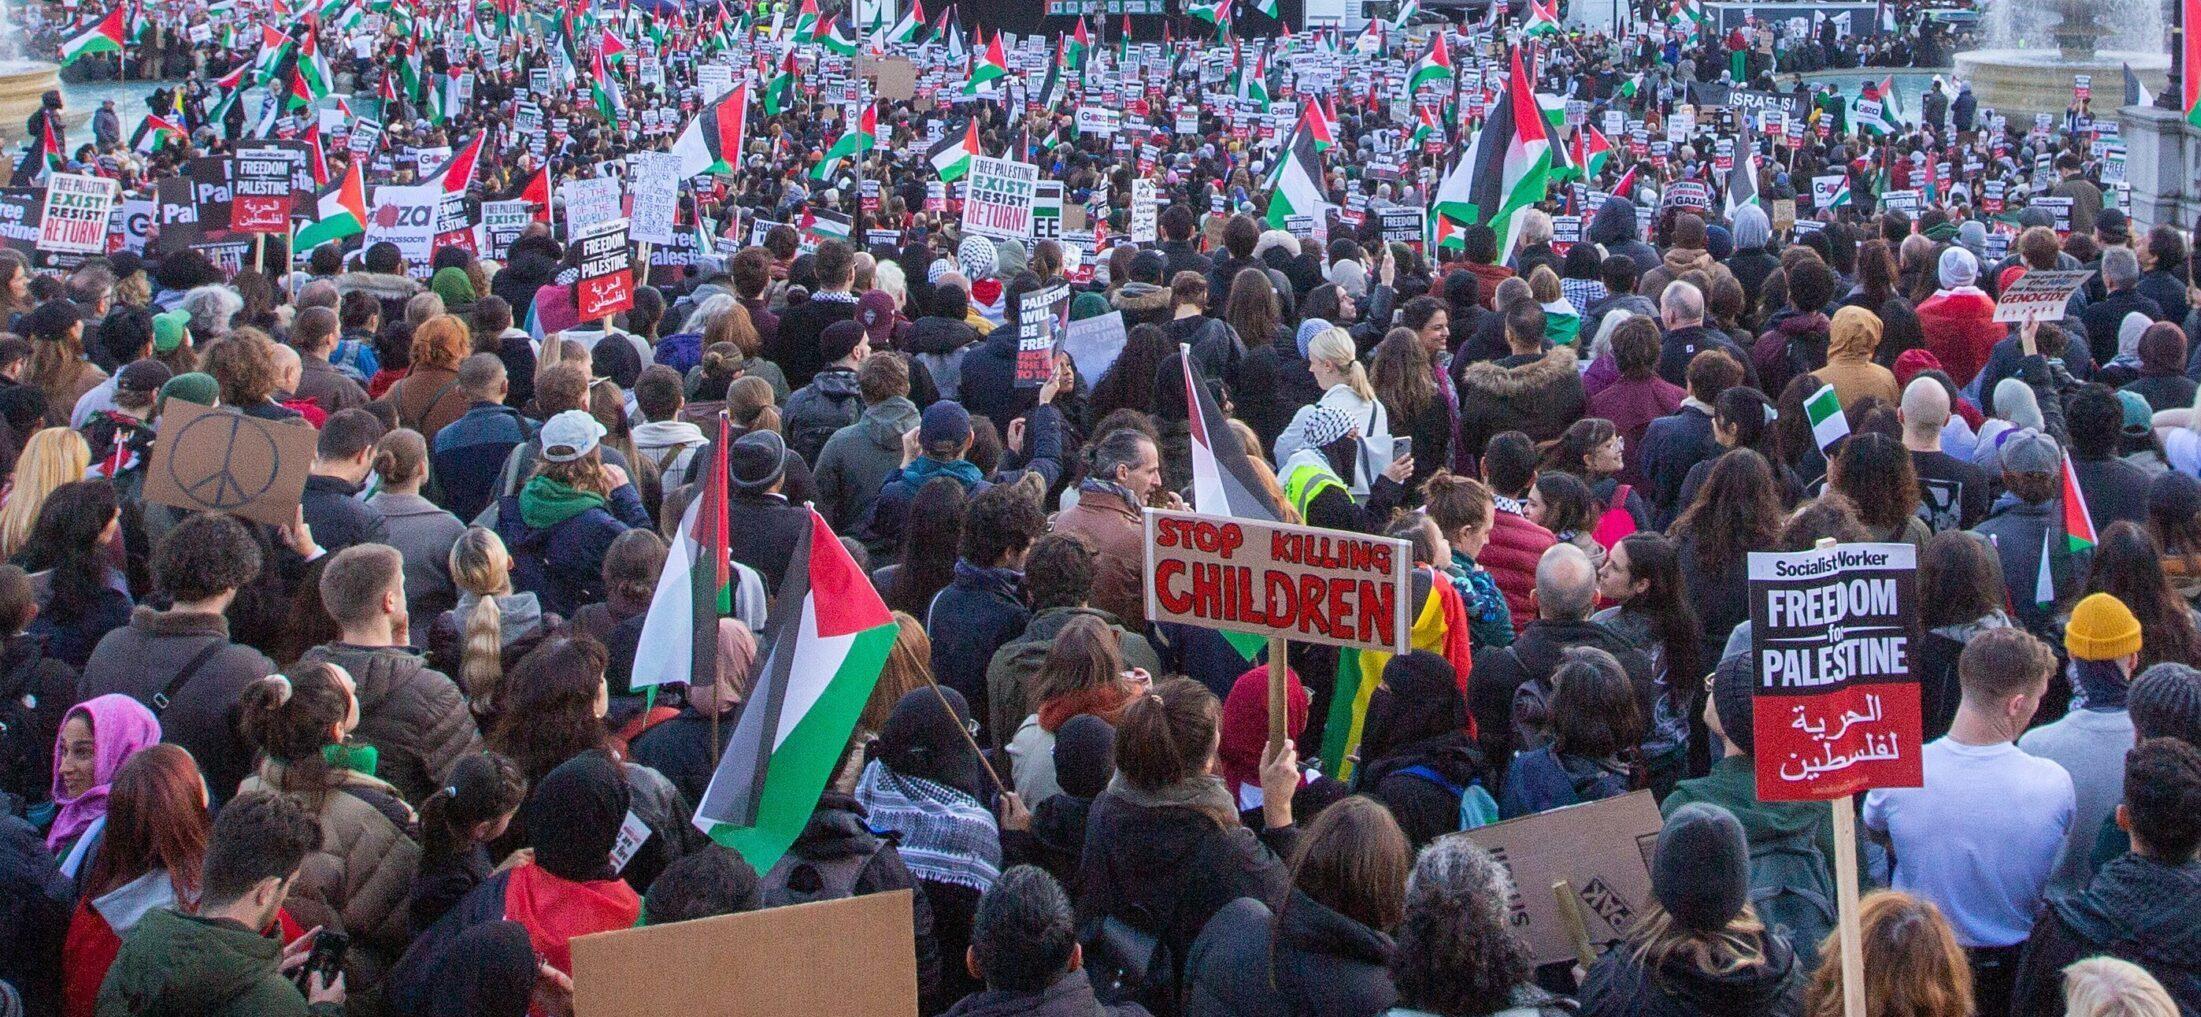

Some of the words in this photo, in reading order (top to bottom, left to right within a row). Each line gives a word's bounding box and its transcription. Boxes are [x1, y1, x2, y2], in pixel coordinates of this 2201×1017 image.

[826, 86, 844, 95] FREE
[1728, 92, 1776, 108] ISRAEL
[1270, 106, 1294, 116] Gaza
[240, 161, 288, 175] FREEDOM
[974, 160, 994, 175] FREE
[994, 161, 1034, 180] PALESTINE
[2104, 161, 2124, 174] FREE
[54, 177, 71, 191] FREE
[74, 180, 109, 195] PALESTINE
[237, 182, 289, 195] PALESTINE
[972, 175, 1032, 196] EXIST!
[51, 192, 107, 209] EXIST!
[575, 190, 585, 200] IS
[592, 188, 610, 196] THE
[970, 189, 1030, 208] RESIST!
[1676, 196, 1703, 206] GAZA
[500, 203, 526, 214] PALESTIN
[575, 206, 589, 215] OF
[592, 204, 610, 212] THE
[1886, 198, 1917, 207] FREEDOM
[0, 202, 24, 220] ree
[49, 207, 105, 221] RESIST!
[575, 212, 608, 224] WORLD
[966, 202, 1028, 232] RETURN!
[486, 214, 529, 225] EXIST!
[755, 222, 772, 232] CEAS
[1384, 216, 1418, 226] FREEDOM
[44, 218, 102, 245] RETURN!
[1034, 218, 1060, 238] EE
[1382, 230, 1422, 242] PALESTINE
[385, 235, 427, 244] massacre
[584, 231, 626, 256] FREEDOM
[671, 233, 697, 247] ree
[1552, 234, 1579, 242] PALESTINE
[582, 253, 628, 278] PALESTINE
[592, 276, 621, 295] الحرية
[588, 288, 626, 312] لفلسطين
[1022, 284, 1070, 311] PALESTINE
[2000, 292, 2068, 304] GENOCIDE
[1021, 306, 1050, 324] WILL
[1021, 324, 1038, 338] BE
[1020, 336, 1051, 352] FREE
[1036, 370, 1050, 379] TH
[1156, 517, 1244, 560] STOP
[1271, 530, 1393, 575] KILLING
[1776, 556, 1838, 577] Socialist
[1154, 558, 1395, 646] CHILDREN
[1767, 578, 1898, 628] FREEDOM
[1827, 623, 1845, 644] for
[1762, 636, 1909, 688] PALESTINE
[1791, 693, 1882, 741] الحرية
[1779, 730, 1900, 782] لفلسطين
